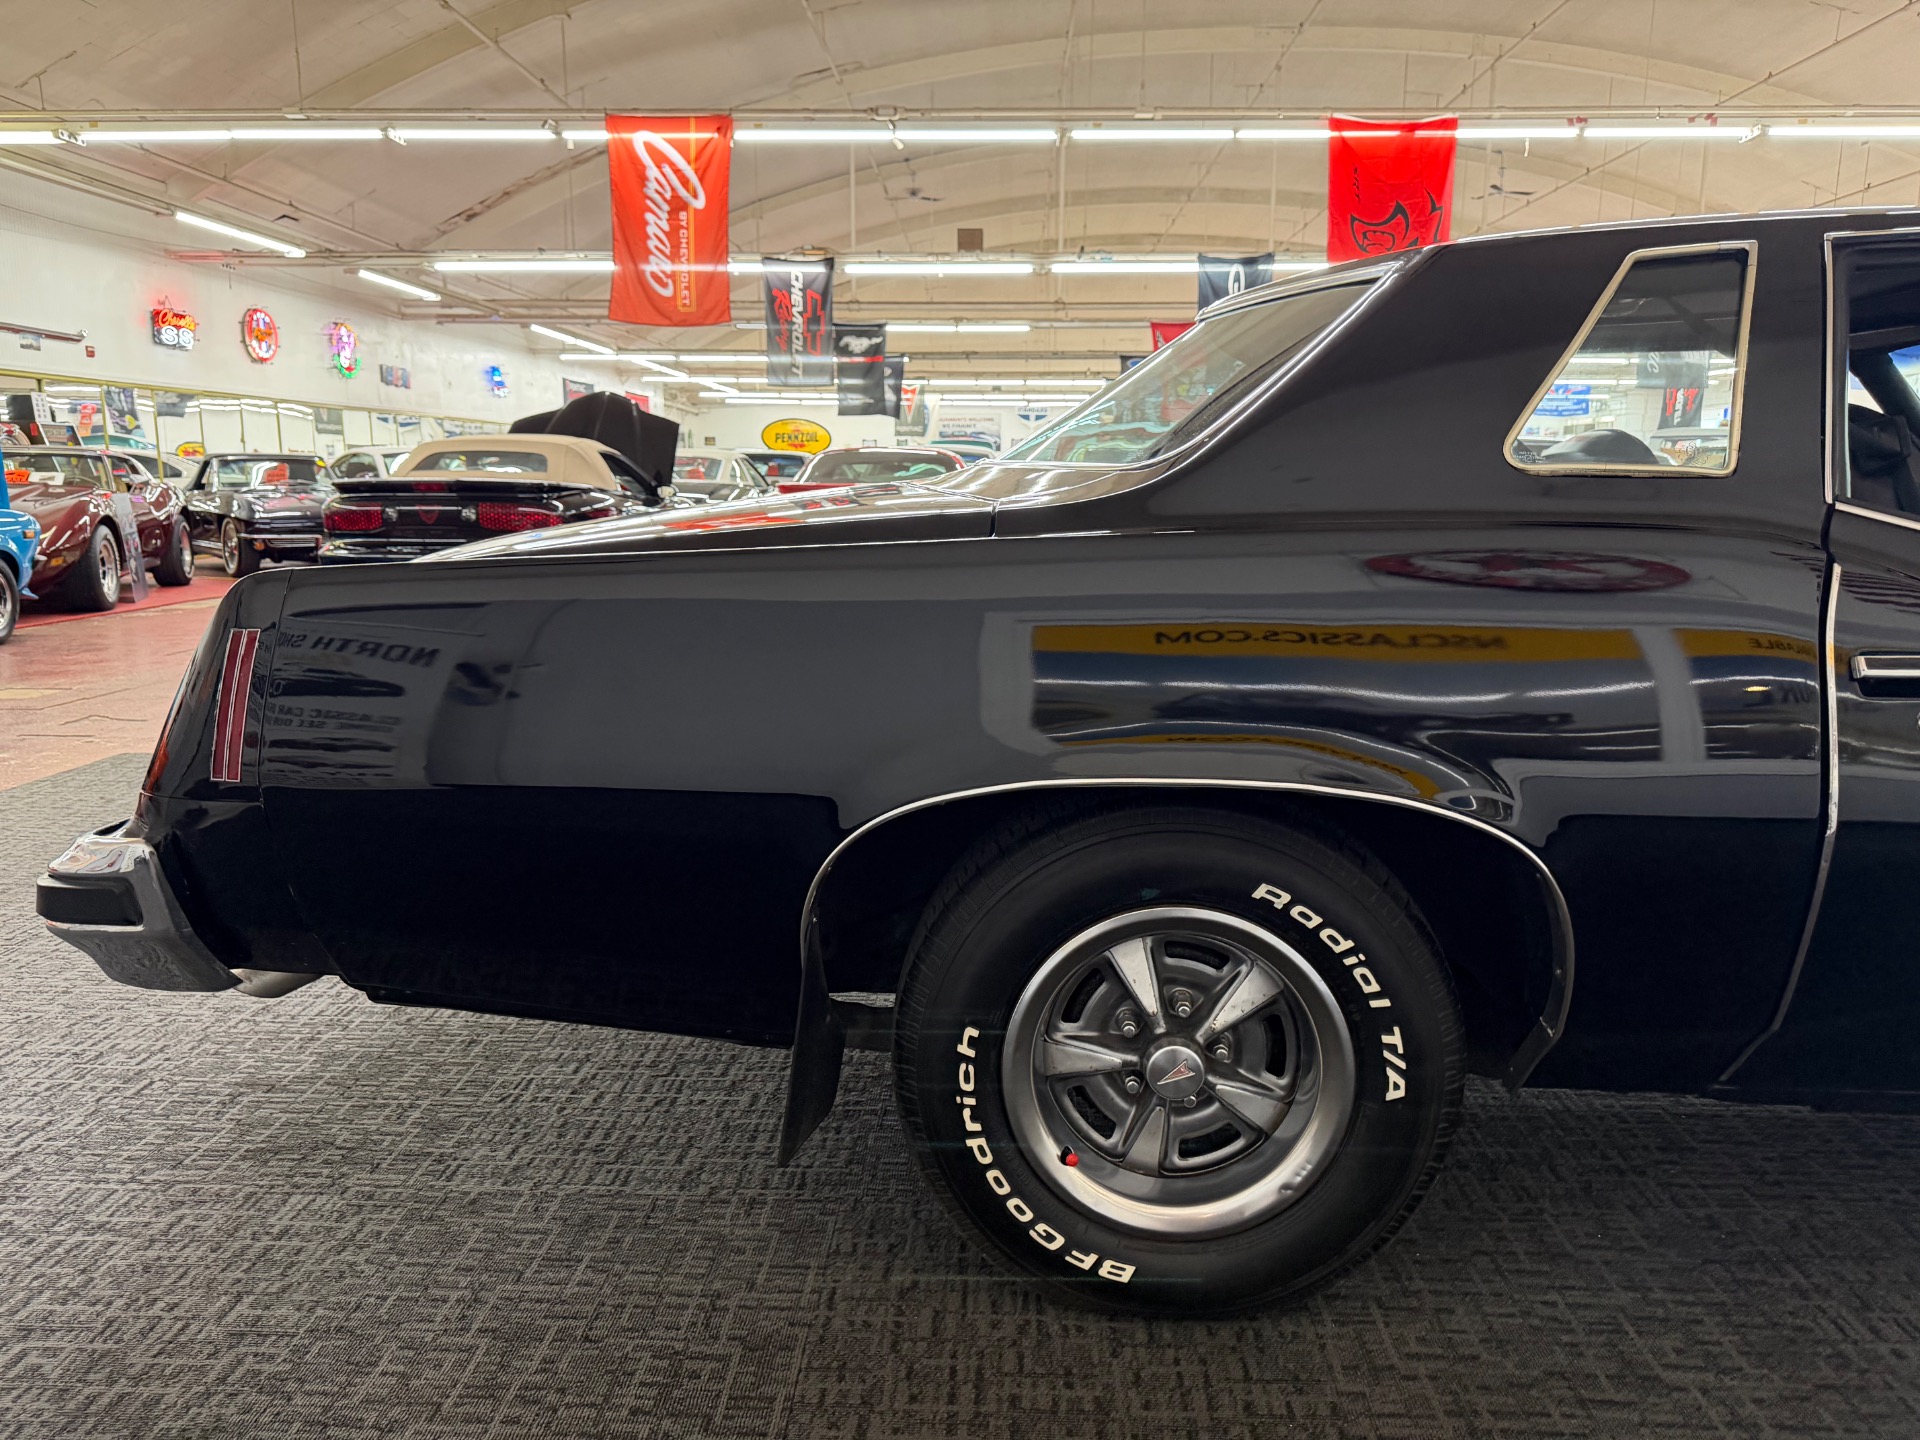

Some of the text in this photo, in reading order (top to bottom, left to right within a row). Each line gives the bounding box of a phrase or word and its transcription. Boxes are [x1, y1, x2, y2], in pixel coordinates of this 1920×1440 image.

[632, 130, 706, 297] Camaro
[678, 211, 690, 306] BY CHEVROLET
[160, 326, 195, 350] SS
[791, 270, 804, 379] CHEVROLET
[774, 431, 820, 444] PENNZOIL
[1251, 882, 1407, 1102] Radial T/A
[955, 1025, 1137, 1284] BFGoodrich
